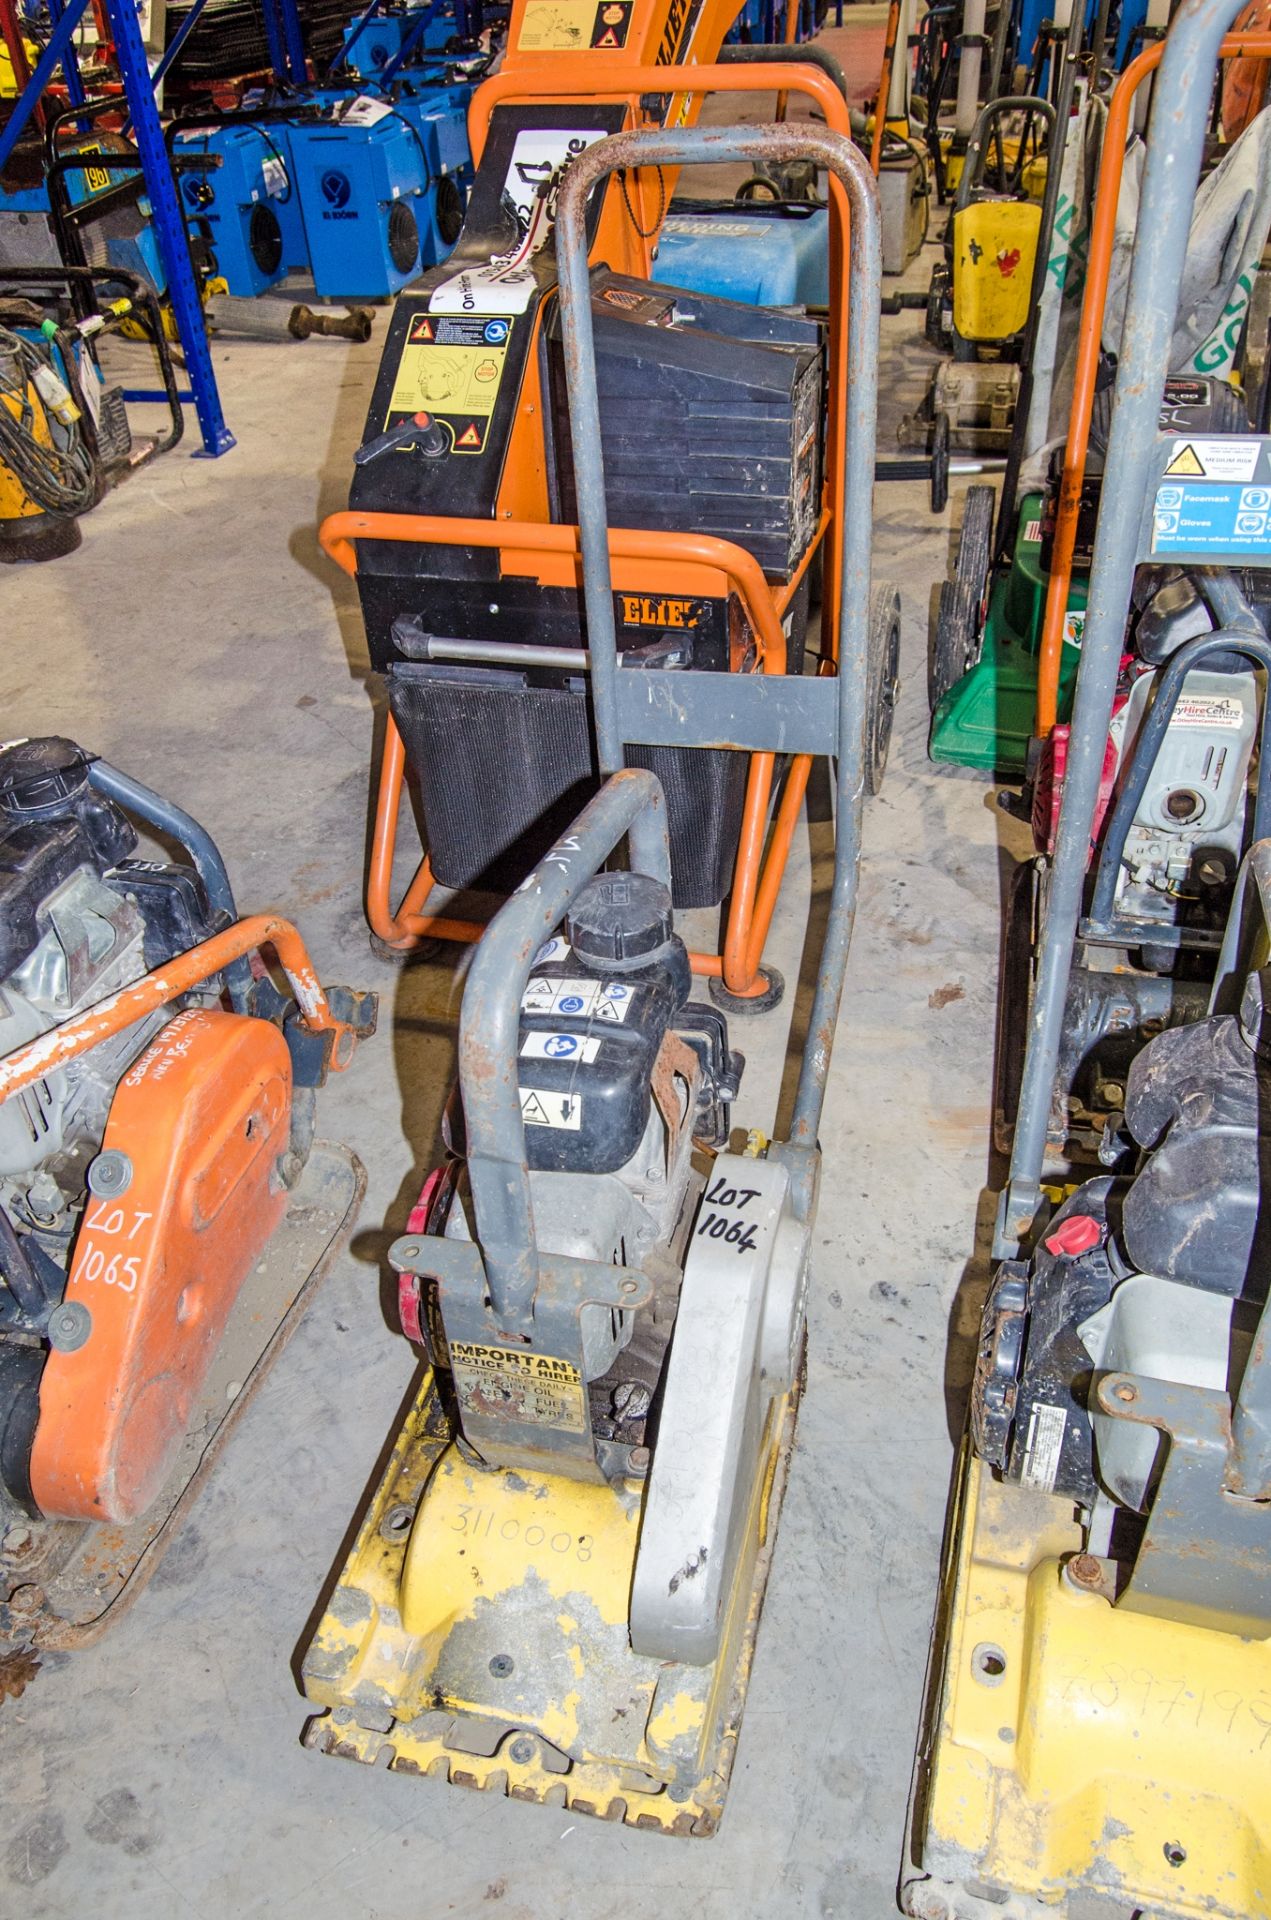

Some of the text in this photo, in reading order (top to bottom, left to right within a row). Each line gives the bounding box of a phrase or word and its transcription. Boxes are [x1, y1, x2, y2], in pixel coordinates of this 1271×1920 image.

[1183, 494, 1230, 503] Facemask
[1180, 519, 1212, 527] Gloves
[705, 1177, 762, 1210] LOT
[85, 1201, 153, 1240] LOT
[698, 1213, 759, 1254] 1064
[73, 1241, 142, 1292] 1065
[534, 1388, 555, 1398] OIL
[451, 1503, 594, 1563] 3110008
